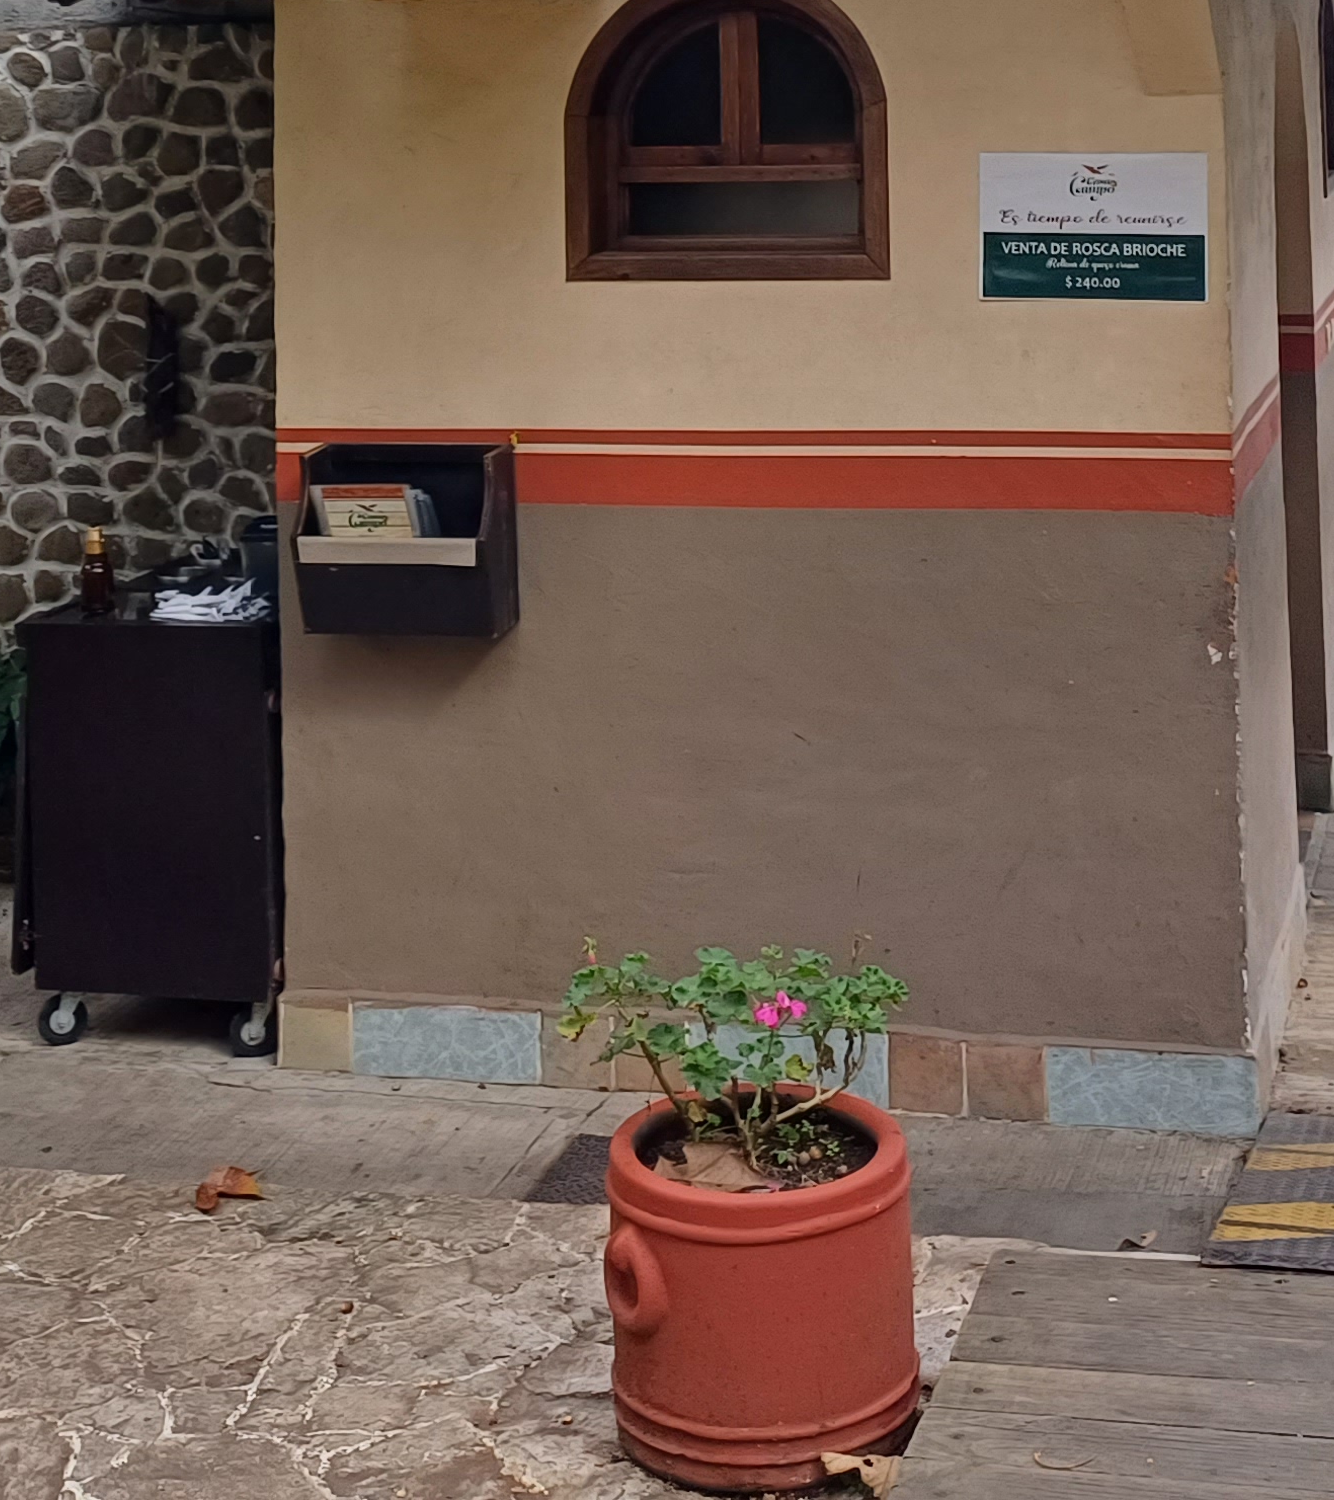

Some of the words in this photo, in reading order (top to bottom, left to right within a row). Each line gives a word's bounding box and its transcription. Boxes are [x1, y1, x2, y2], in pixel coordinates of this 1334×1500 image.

[1027, 211, 1083, 230] tiempo
[1089, 209, 1110, 225] de
[1001, 241, 1048, 255] VENTA
[1051, 242, 1069, 255] DE
[1072, 242, 1120, 257] ROSCA
[1123, 243, 1187, 257] BRIOCHE
[1065, 276, 1073, 288] $
[1075, 277, 1121, 290] 240.00
